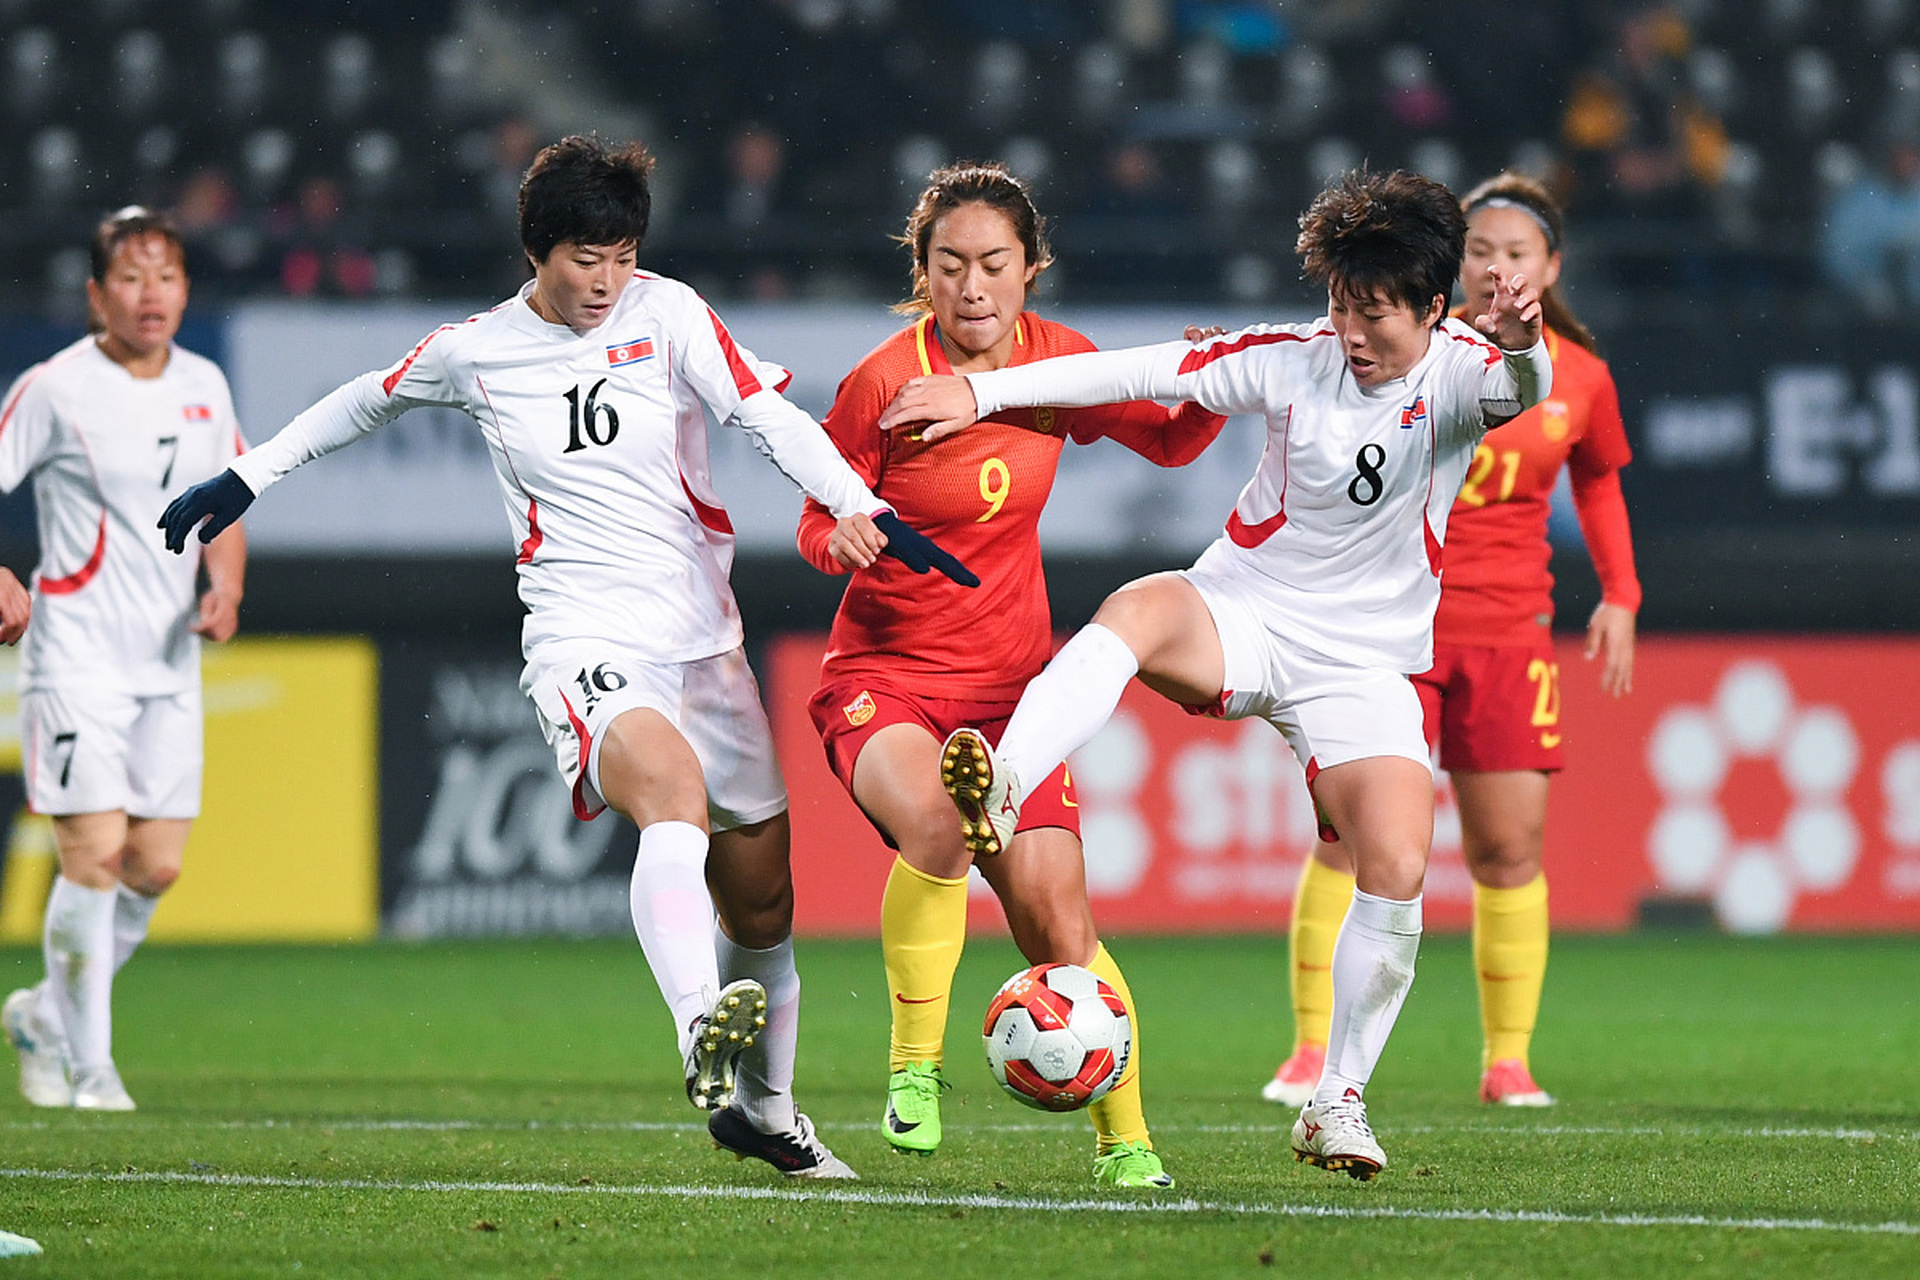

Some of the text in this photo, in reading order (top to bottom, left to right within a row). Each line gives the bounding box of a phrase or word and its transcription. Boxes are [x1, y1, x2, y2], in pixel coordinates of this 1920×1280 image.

[563, 378, 619, 453] 16
[157, 436, 178, 490] 7
[976, 457, 1011, 523] 9
[1347, 443, 1386, 506] 8
[1460, 444, 1520, 506] 21
[574, 662, 628, 717] 16
[54, 733, 77, 789] 7
